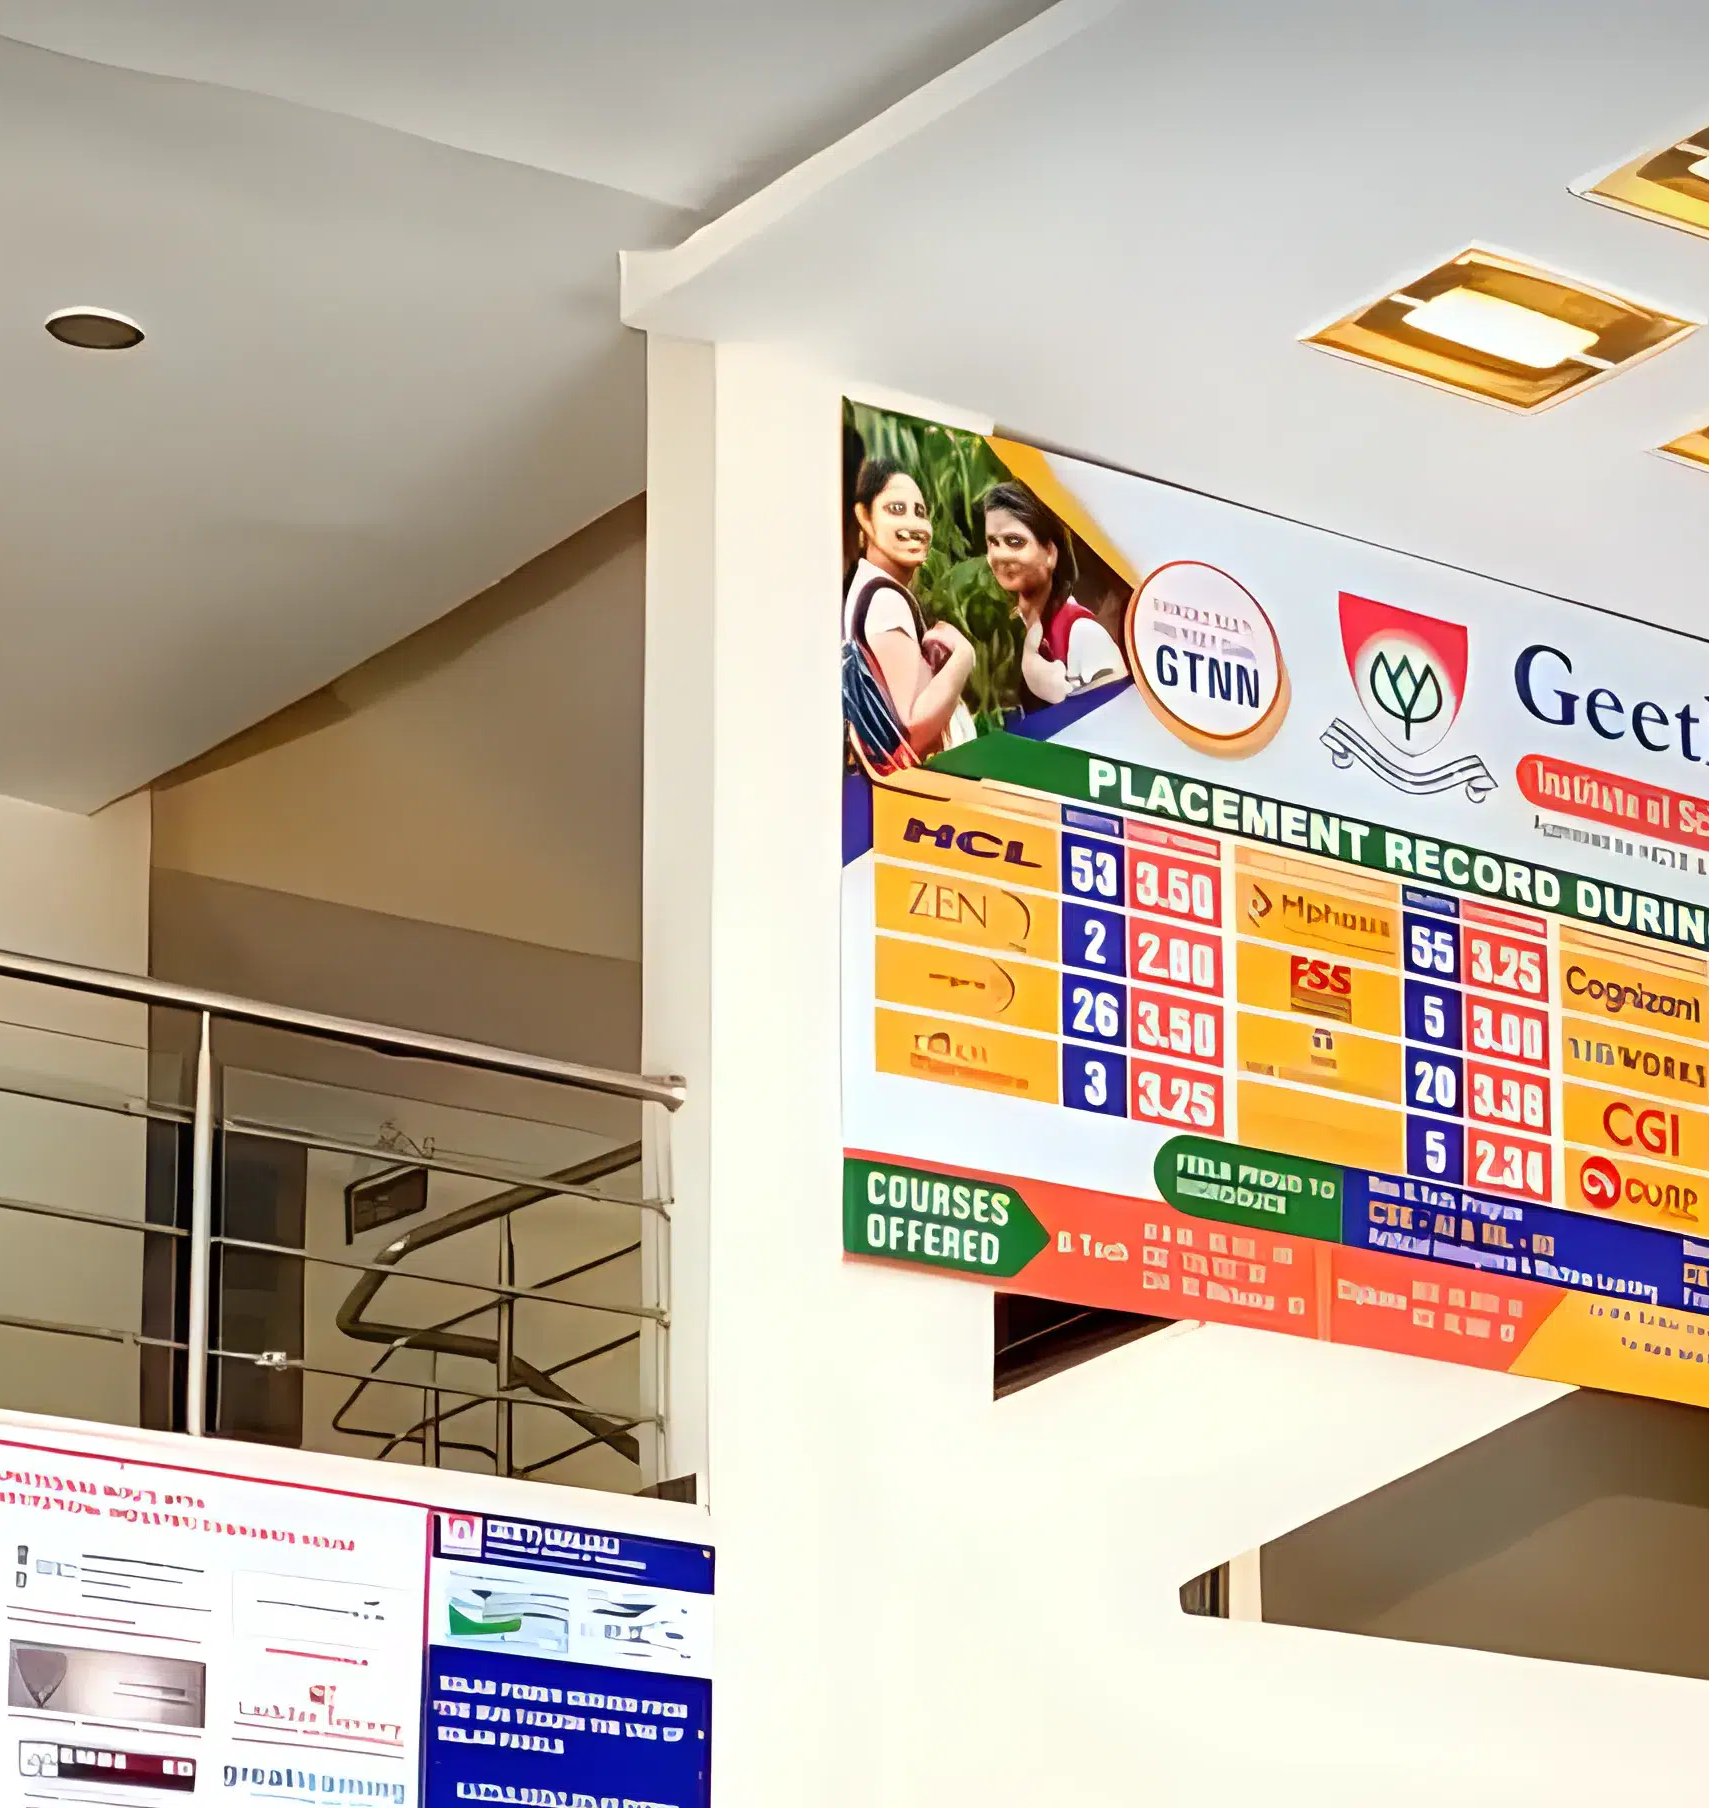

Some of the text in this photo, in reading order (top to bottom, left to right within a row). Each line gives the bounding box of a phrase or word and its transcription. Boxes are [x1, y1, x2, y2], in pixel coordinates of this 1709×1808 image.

[1155, 644, 1260, 708] GTNN
[1089, 758, 1370, 862] PLACEMENT
[1385, 831, 1559, 907] RECORD
[903, 817, 1214, 921] HCL 53 3.50
[1084, 919, 1107, 965] 2
[1411, 925, 1541, 994] 55 3.25
[1073, 987, 1216, 1059] 26 3.50
[1565, 965, 1701, 1023] Cognizant
[1424, 995, 1445, 1038] 5
[1473, 1004, 1543, 1061] 3.00
[1084, 1061, 1215, 1127] 3 3.25
[1414, 1061, 1456, 1109] 20
[1426, 1130, 1446, 1174] 5
[1602, 1101, 1680, 1157] CGI
[867, 1171, 1010, 1226] COURSES
[867, 1213, 1000, 1266] OFFERED
